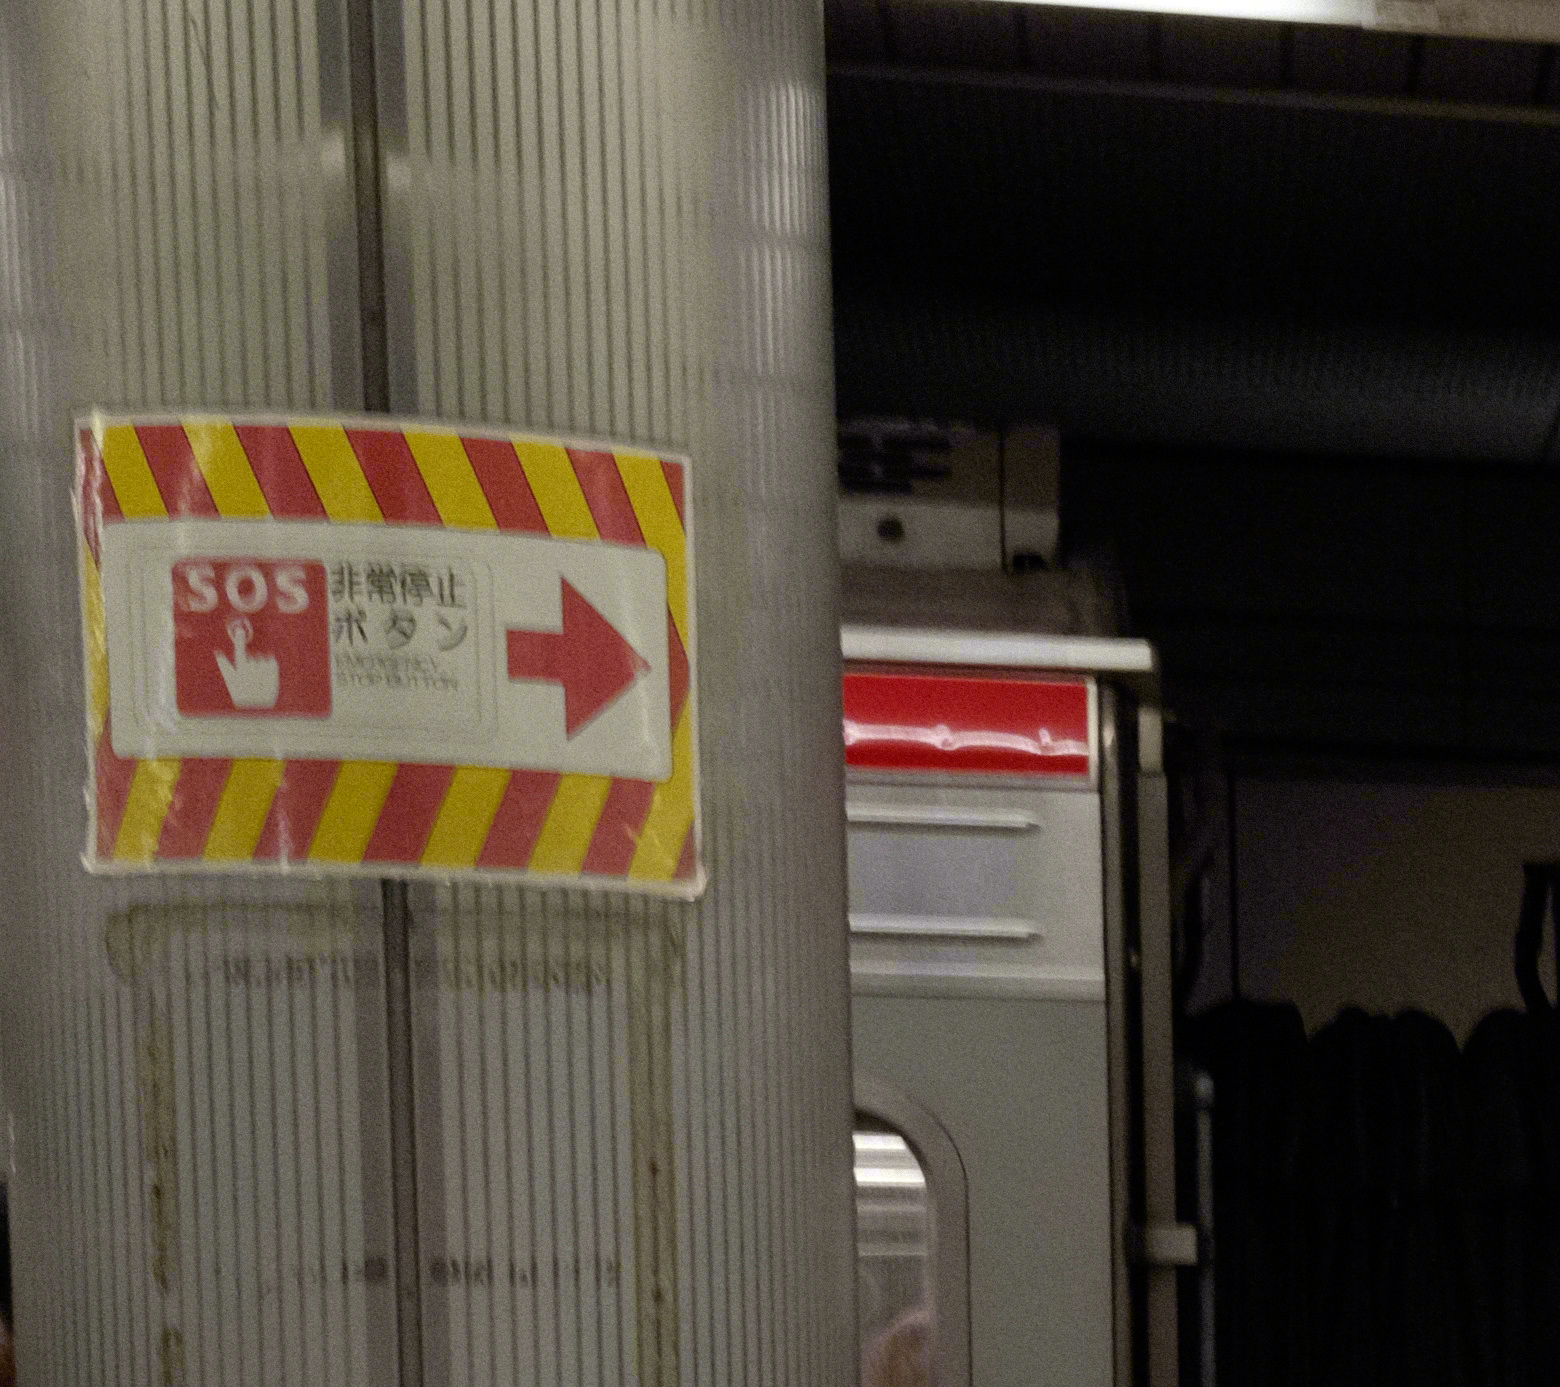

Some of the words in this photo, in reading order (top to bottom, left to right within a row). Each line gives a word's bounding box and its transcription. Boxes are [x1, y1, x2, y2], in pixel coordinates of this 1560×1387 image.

[180, 564, 310, 615] SOS
[330, 561, 469, 609] 非常停止
[331, 608, 469, 651] ボタン
